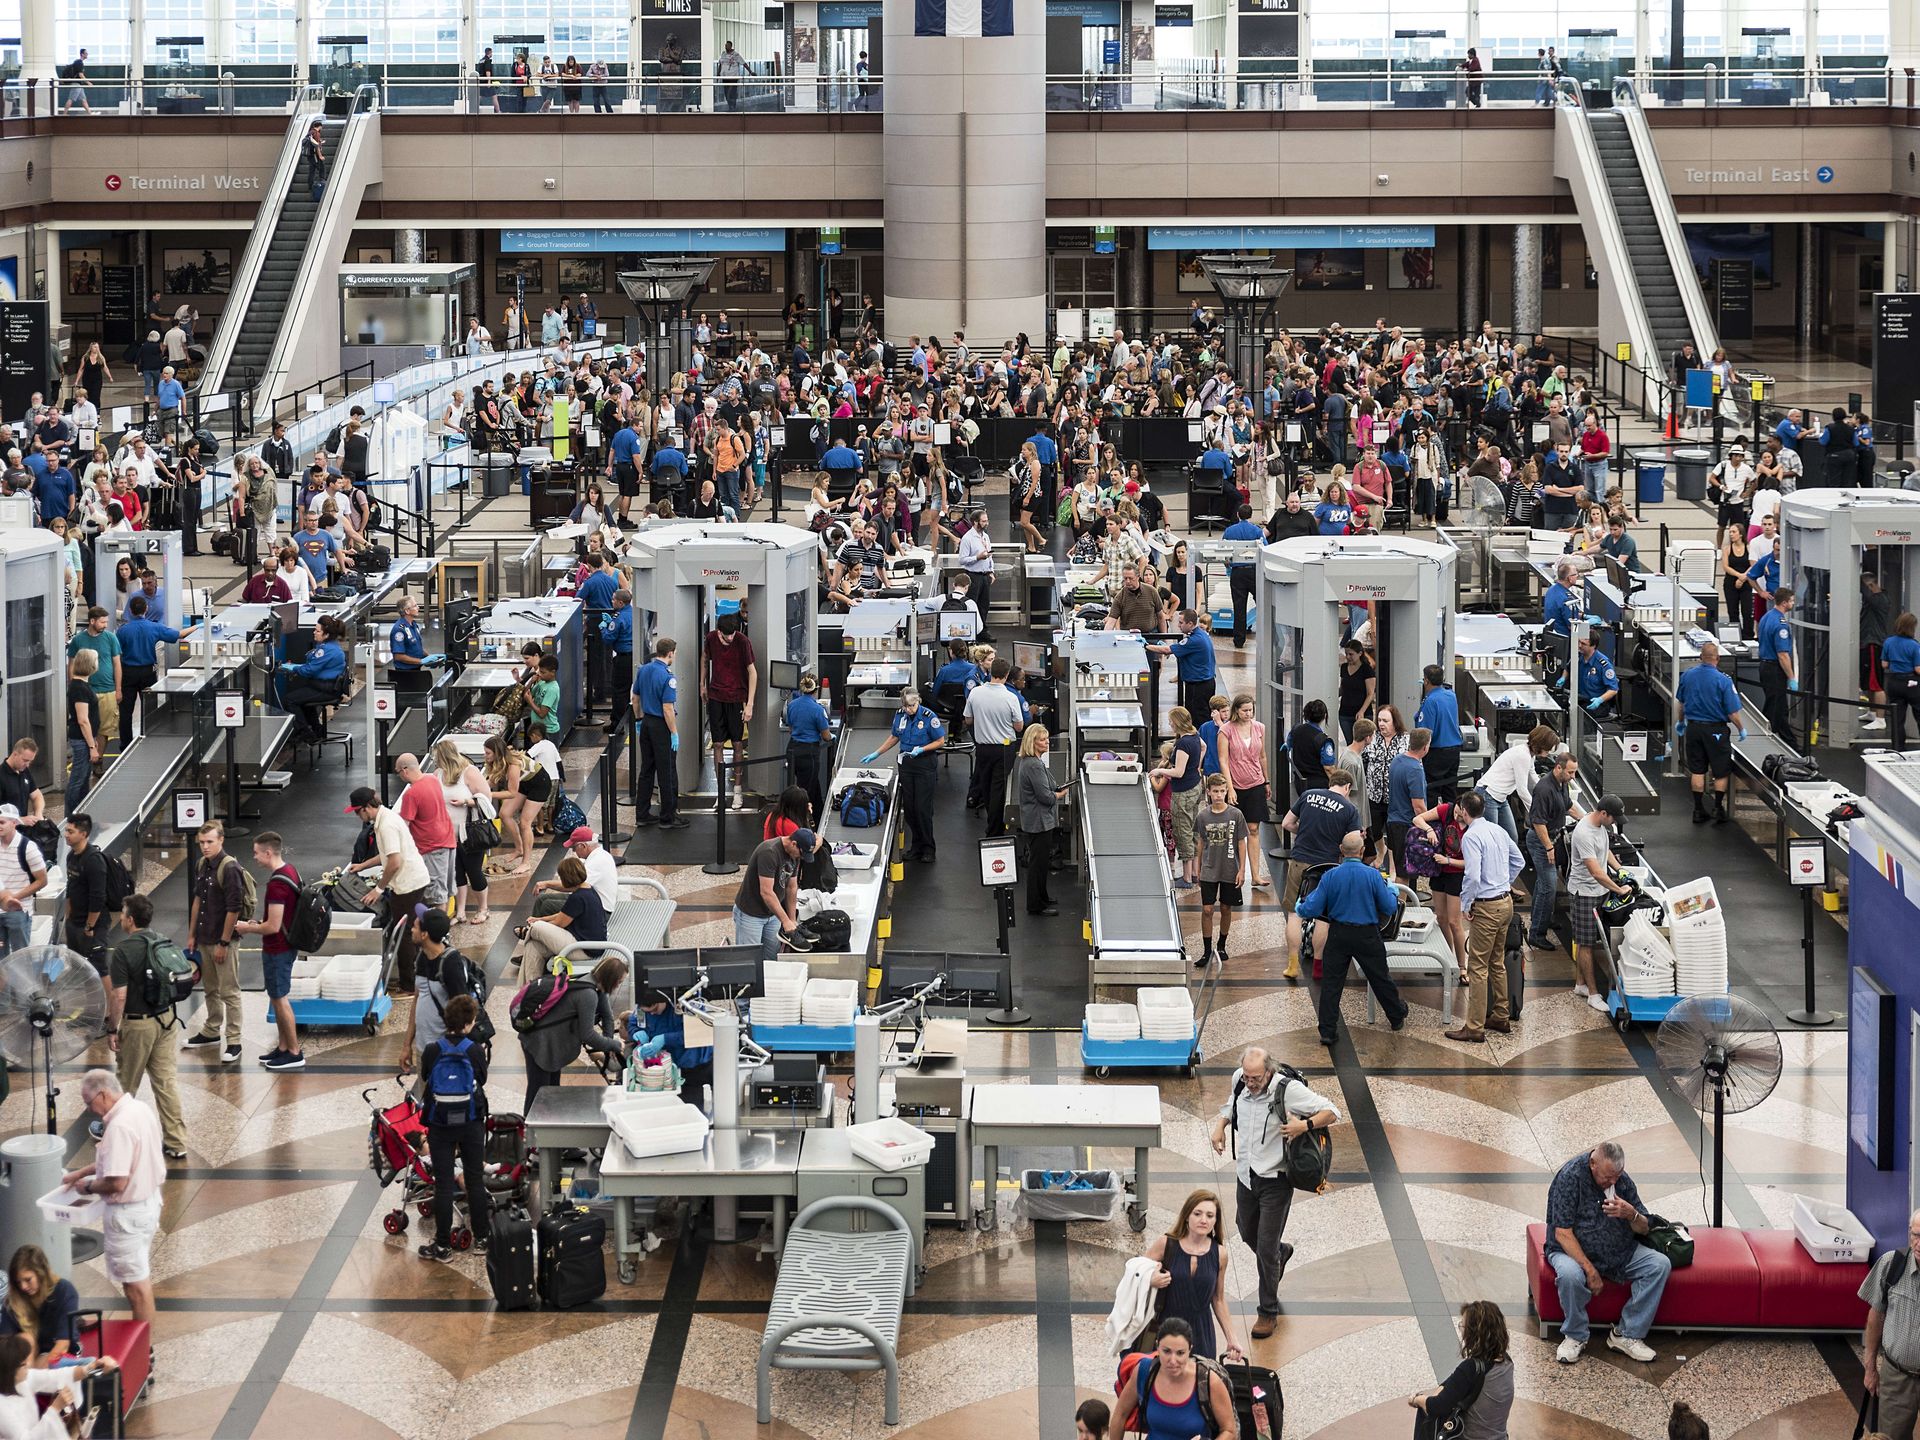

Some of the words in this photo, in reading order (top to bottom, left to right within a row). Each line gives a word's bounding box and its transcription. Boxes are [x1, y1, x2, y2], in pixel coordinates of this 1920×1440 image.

[666, 0, 691, 12] MINES
[1685, 166, 1762, 183] Terminal
[1772, 168, 1809, 183] East
[129, 174, 205, 190] Terminal
[214, 175, 260, 190] West
[527, 231, 550, 239] Baggage
[357, 276, 392, 284] CURRENCY
[393, 276, 429, 284] EXCHANGE
[1330, 509, 1349, 522] KC
[148, 540, 159, 552] 2
[911, 603, 916, 613] 5
[204, 609, 209, 618] 3
[1573, 623, 1578, 632] 7
[1070, 641, 1075, 650] 6
[366, 646, 371, 656] 4
[1306, 794, 1326, 804] CAPE
[1325, 798, 1344, 812] MAY
[1228, 820, 1236, 858] COLORADO
[992, 862, 1005, 870] STOP
